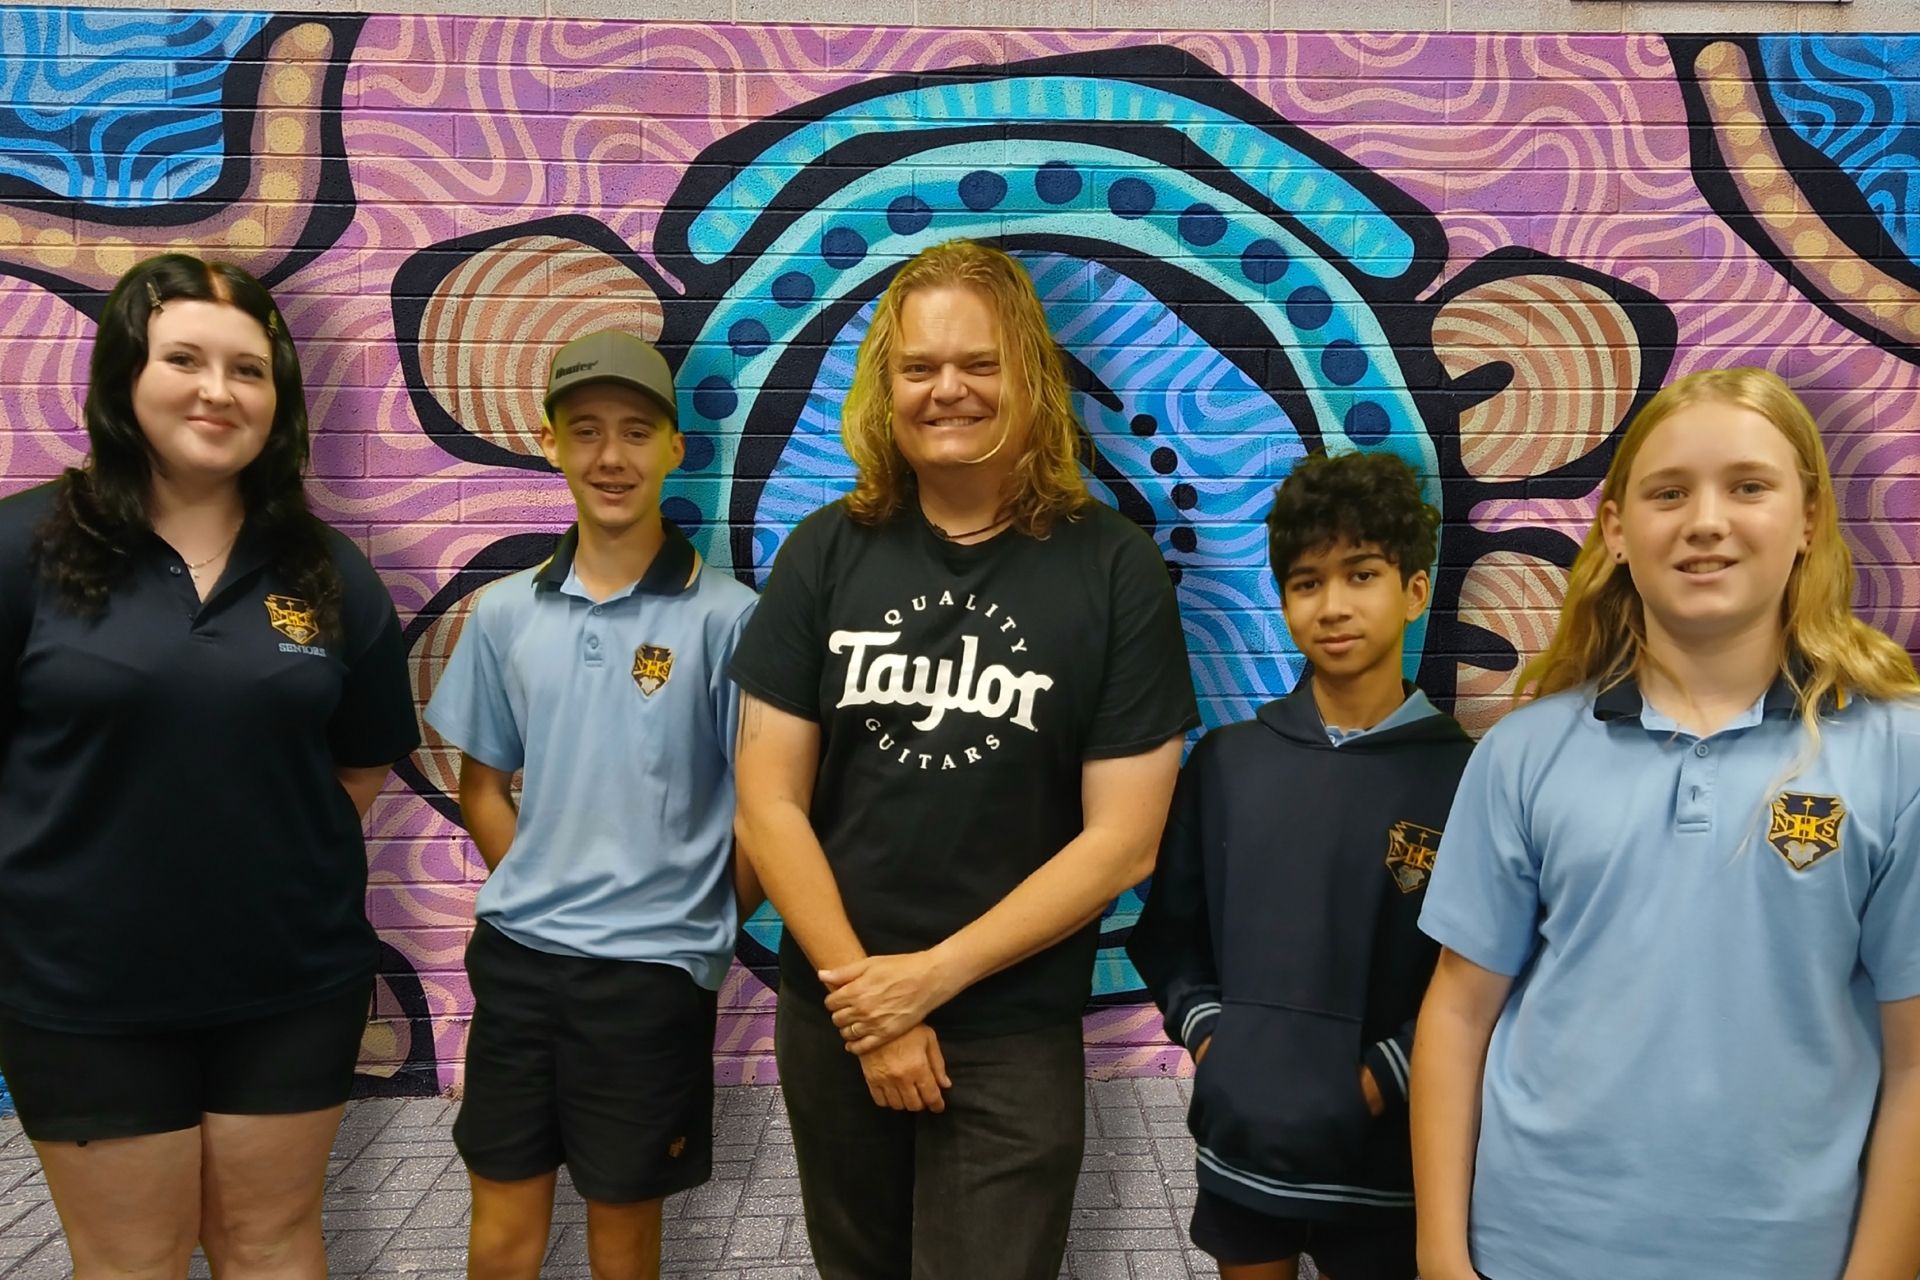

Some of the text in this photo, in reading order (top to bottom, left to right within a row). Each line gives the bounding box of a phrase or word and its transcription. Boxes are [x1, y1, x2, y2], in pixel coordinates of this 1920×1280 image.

[884, 590, 1027, 653] QUALITY
[278, 643, 327, 657] SENIORS
[828, 630, 1054, 732] Taylor
[865, 718, 1001, 770] GUITARS
[1772, 814, 1837, 840] NHS
